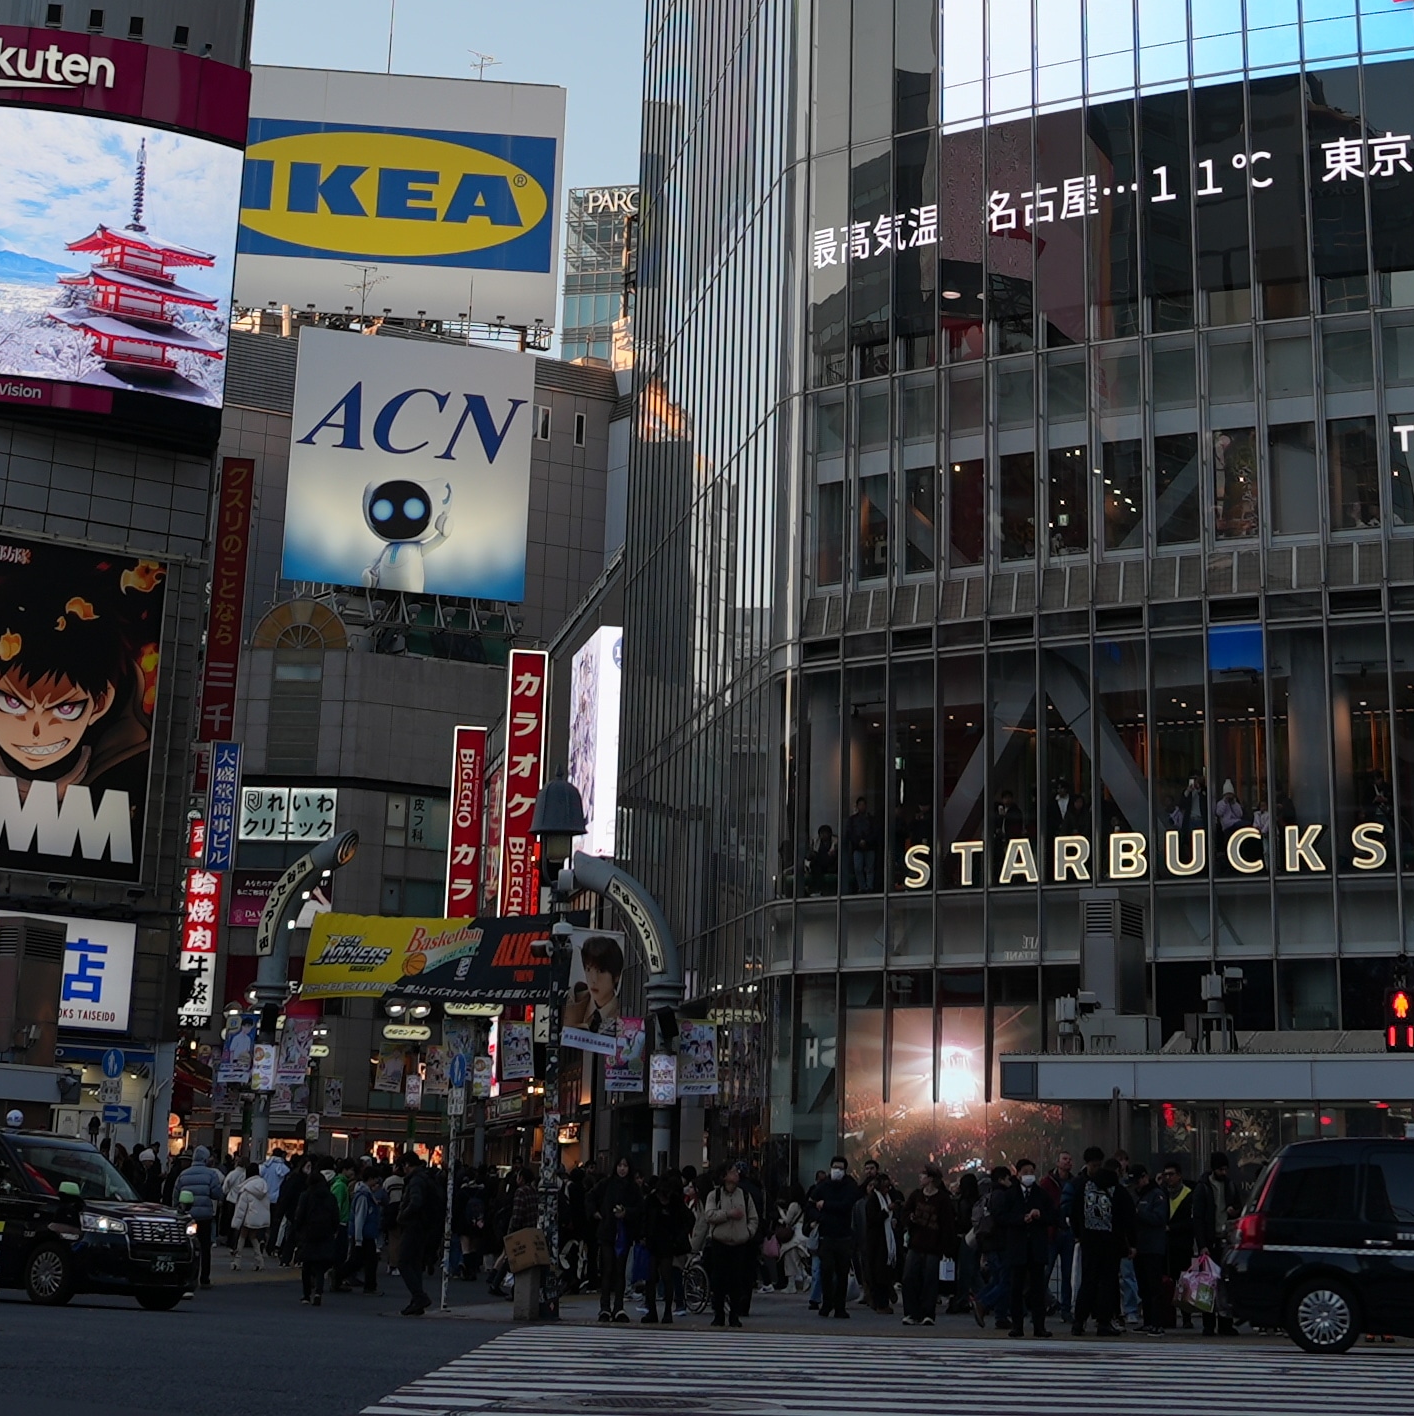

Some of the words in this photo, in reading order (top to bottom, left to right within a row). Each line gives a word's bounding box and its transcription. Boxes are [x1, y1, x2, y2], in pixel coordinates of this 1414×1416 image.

[243, 158, 524, 227] IKEA
[813, 204, 942, 270] 最高気温
[296, 381, 528, 464] ACN
[215, 467, 249, 646] クスリのことなら
[459, 748, 476, 778] BIG
[507, 672, 541, 818] カラオケ
[208, 749, 236, 864] 大盛堂商事ビル
[243, 818, 333, 837] クリニック
[267, 793, 334, 813] れいわ
[411, 798, 425, 843] 皮フ科
[456, 781, 473, 828] ECHO
[452, 843, 477, 917] カラ
[508, 836, 526, 874] BIG
[903, 821, 1388, 889] STARBUCKS
[78, 1009, 115, 1022] TAISEIDO
